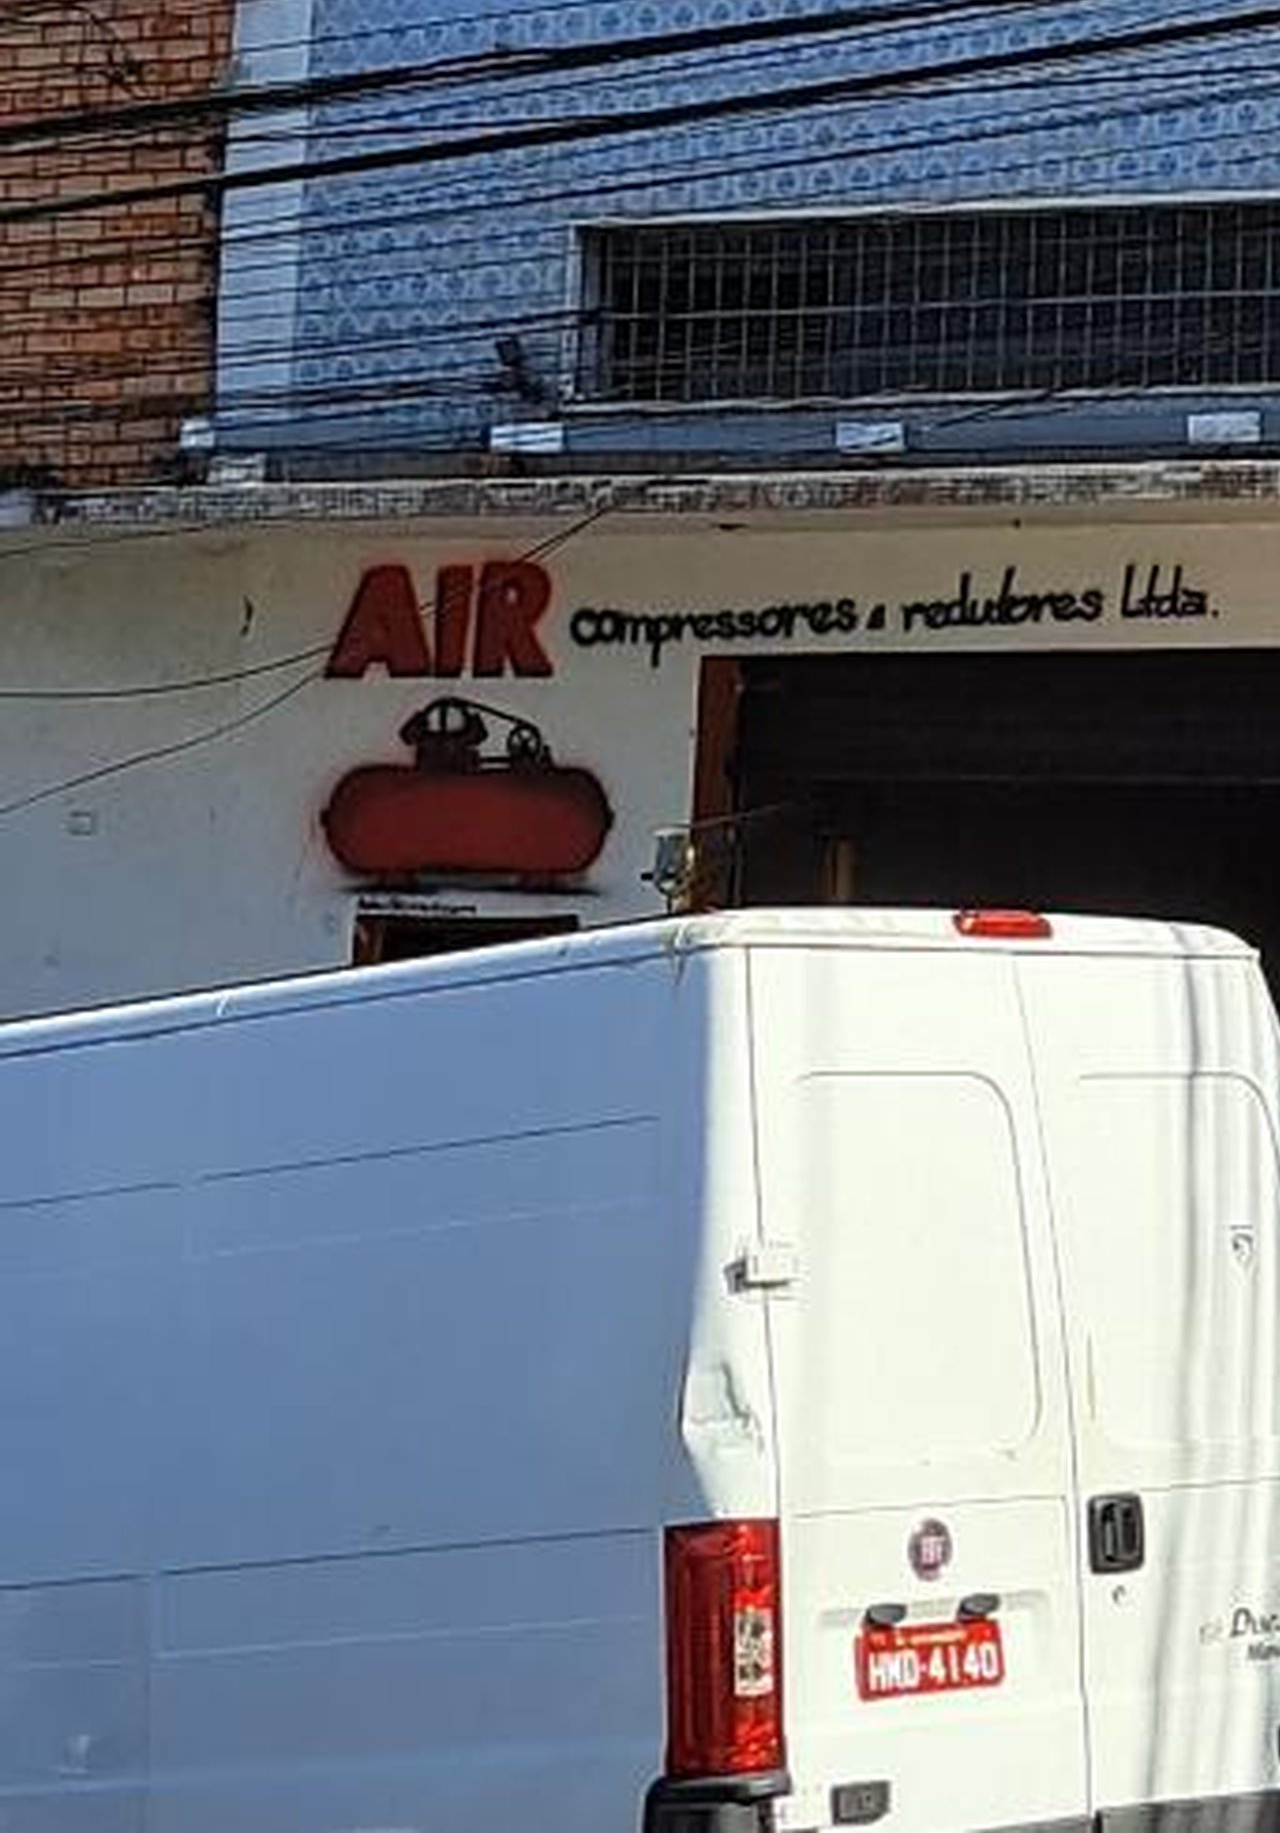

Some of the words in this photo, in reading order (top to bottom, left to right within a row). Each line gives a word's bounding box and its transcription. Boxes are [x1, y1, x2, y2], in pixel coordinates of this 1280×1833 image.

[324, 561, 554, 678] AIR
[569, 597, 856, 667] compressores
[900, 570, 1104, 633] redutores
